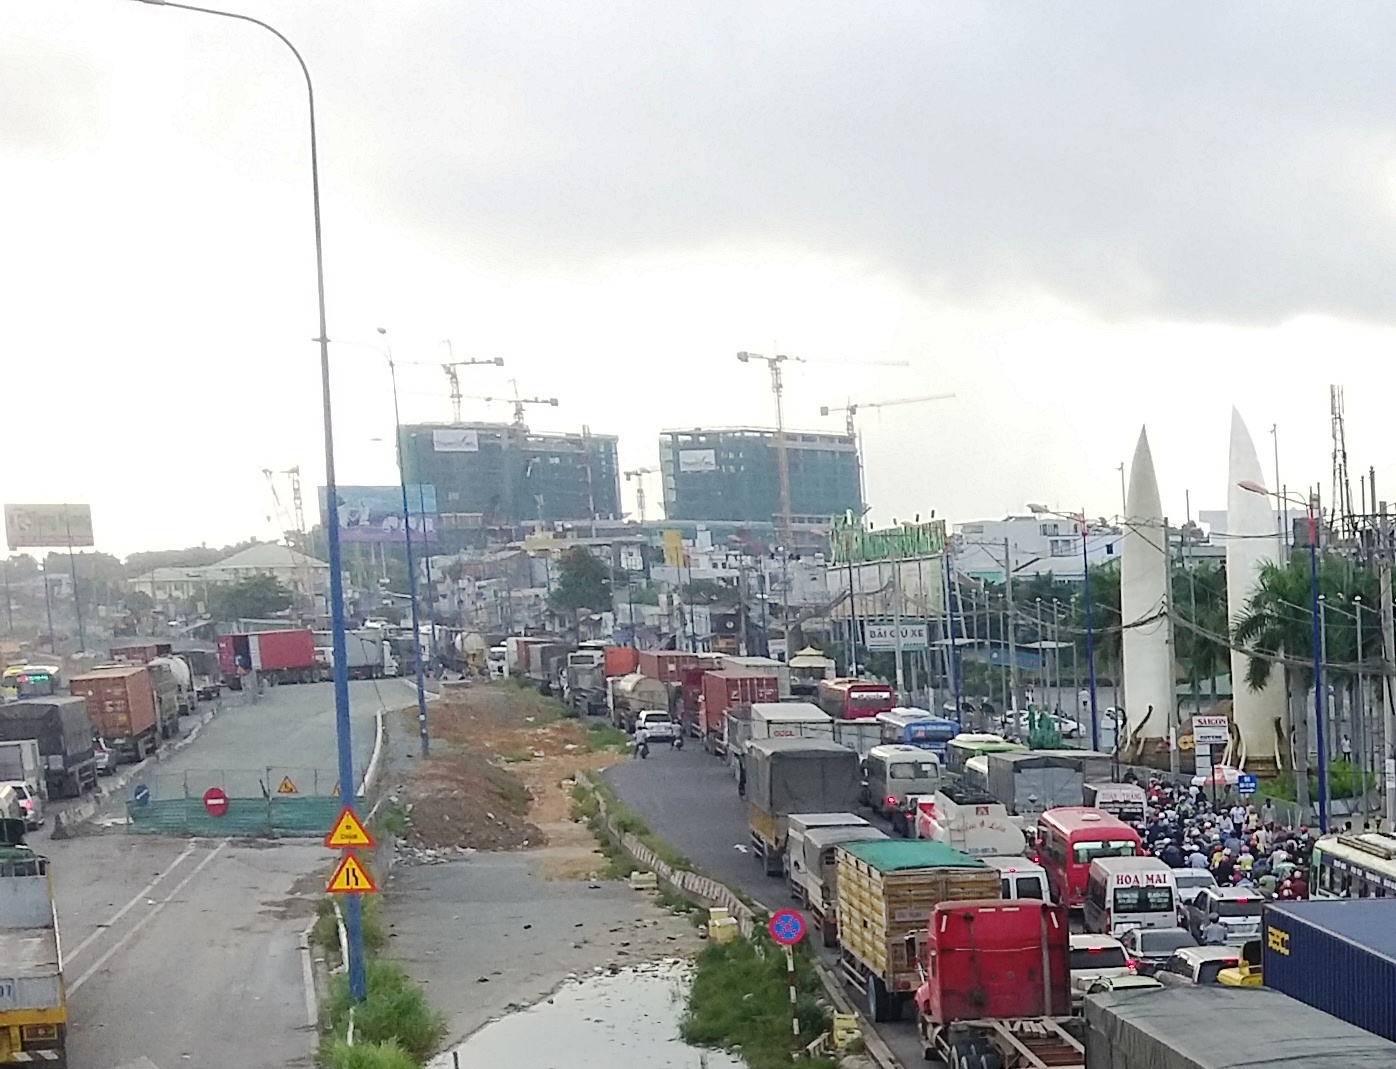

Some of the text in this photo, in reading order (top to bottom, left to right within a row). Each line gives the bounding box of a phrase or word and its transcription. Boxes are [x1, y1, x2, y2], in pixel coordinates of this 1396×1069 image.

[910, 629, 925, 638] XE
[1116, 873, 1167, 885] HOA MAI
